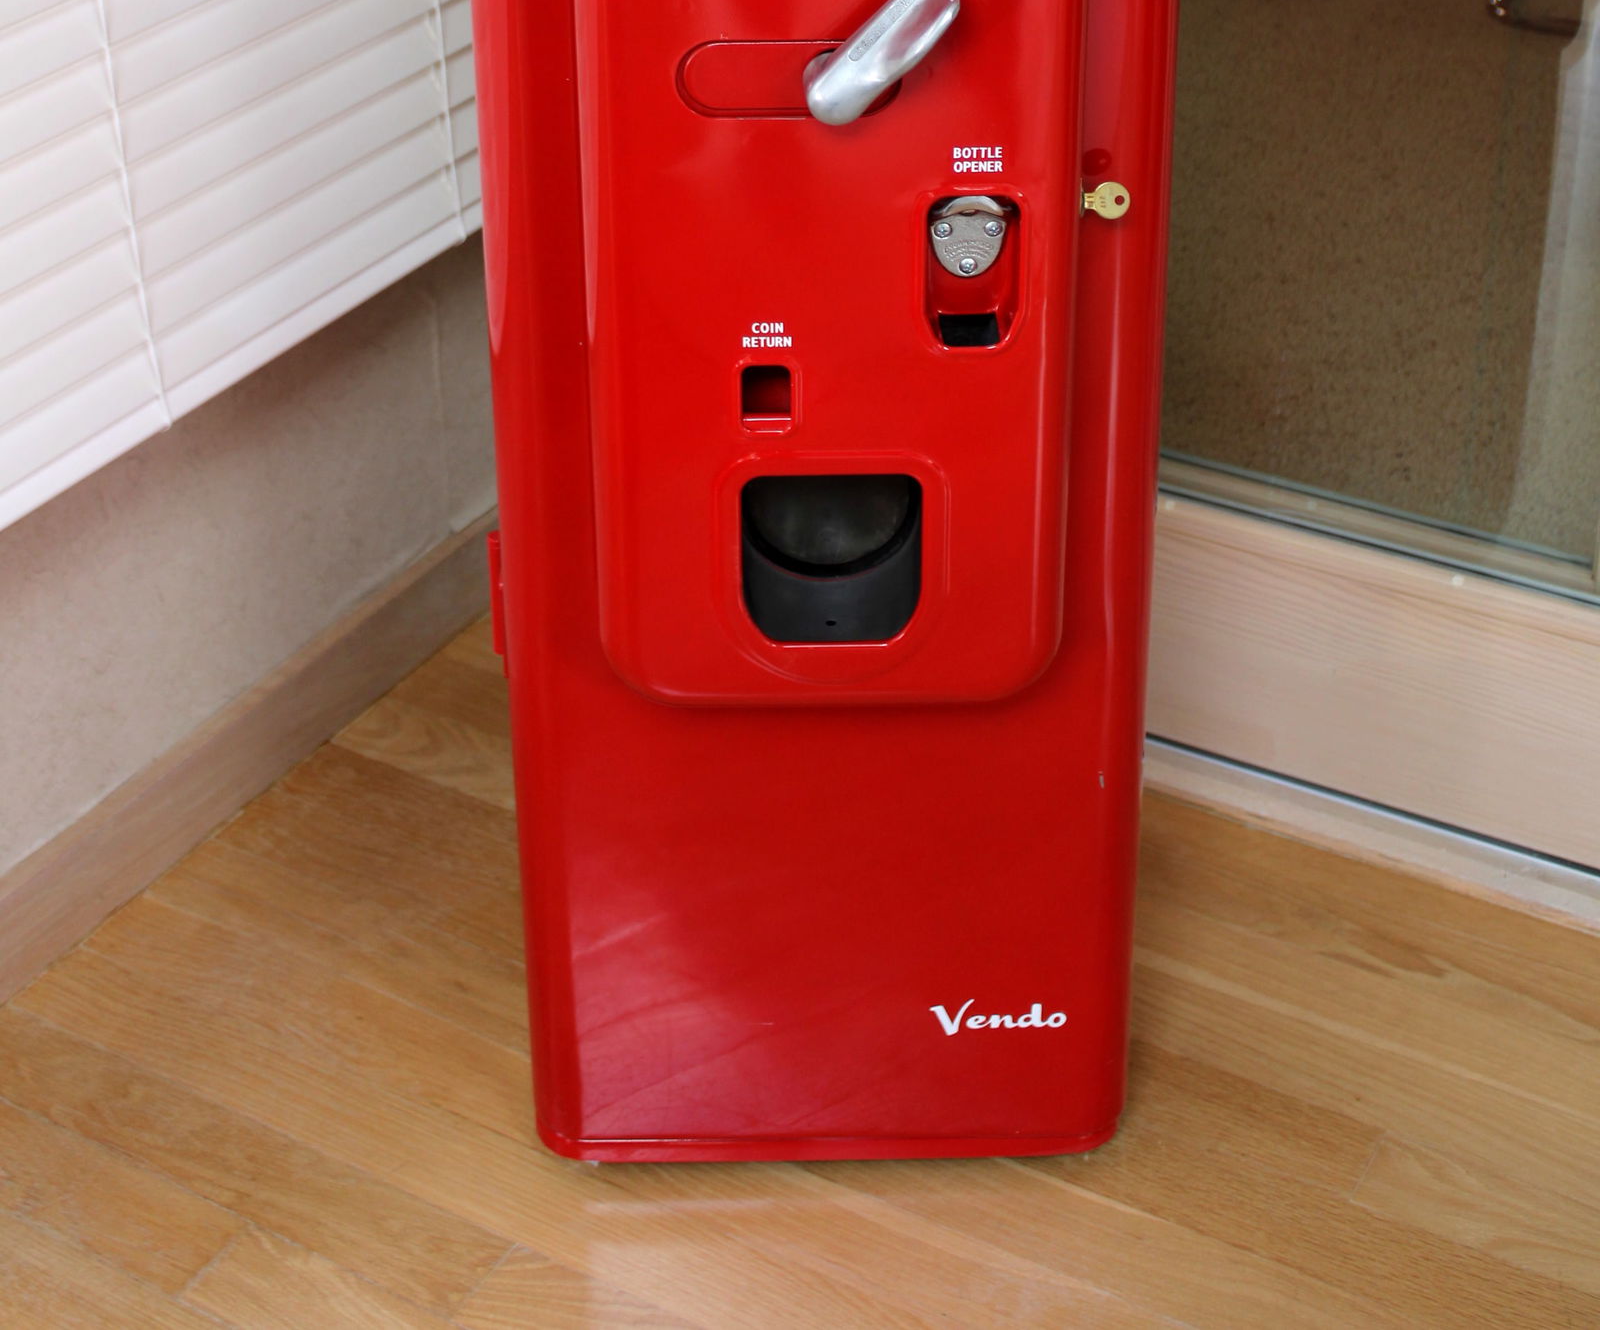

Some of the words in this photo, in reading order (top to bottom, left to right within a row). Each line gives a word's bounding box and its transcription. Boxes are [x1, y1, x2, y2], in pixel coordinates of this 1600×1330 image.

[953, 146, 1003, 159] BOTTLE
[953, 160, 1003, 173] OPENER
[751, 322, 784, 334] COIN
[742, 336, 792, 348] RETURN
[929, 998, 1067, 1036] Vendo
